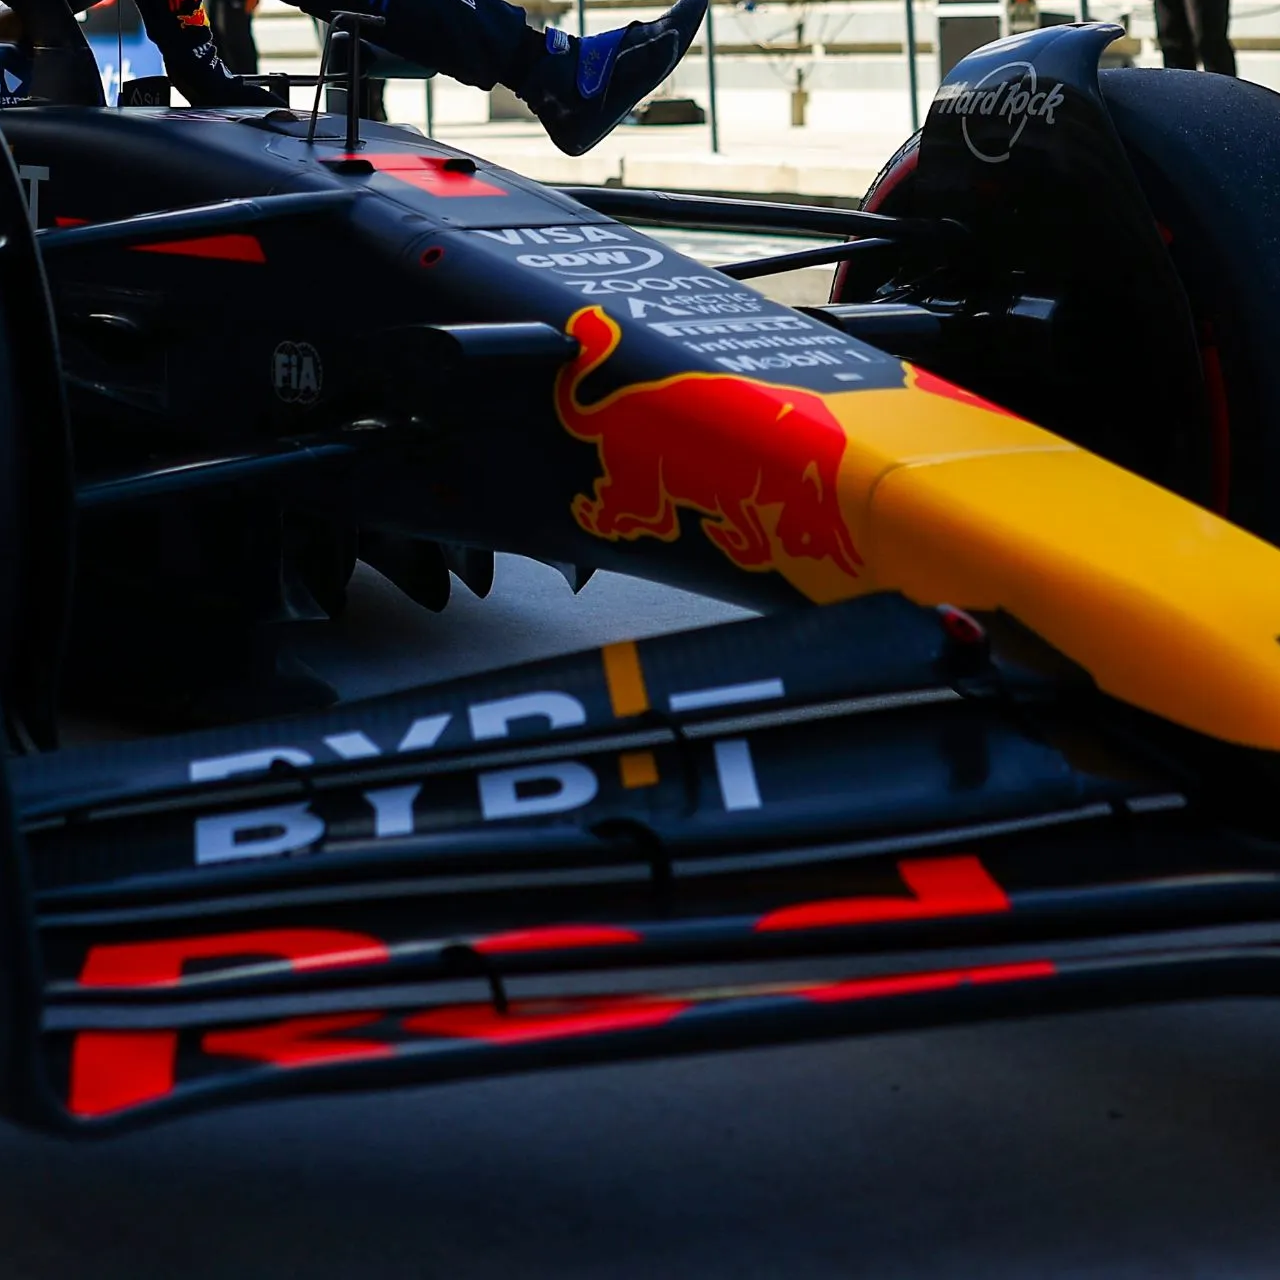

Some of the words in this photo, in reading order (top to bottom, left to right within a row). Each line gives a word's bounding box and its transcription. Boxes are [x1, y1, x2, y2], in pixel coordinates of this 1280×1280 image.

[937, 81, 1008, 115] Hard
[478, 226, 630, 245] VISA
[516, 247, 633, 268] CDW
[564, 275, 729, 295] zoom
[647, 316, 813, 337] PIRELLI
[685, 334, 849, 354] infinitum
[275, 352, 319, 392] FIA
[715, 351, 835, 372] Mobil
[190, 642, 786, 865] BYBIT
